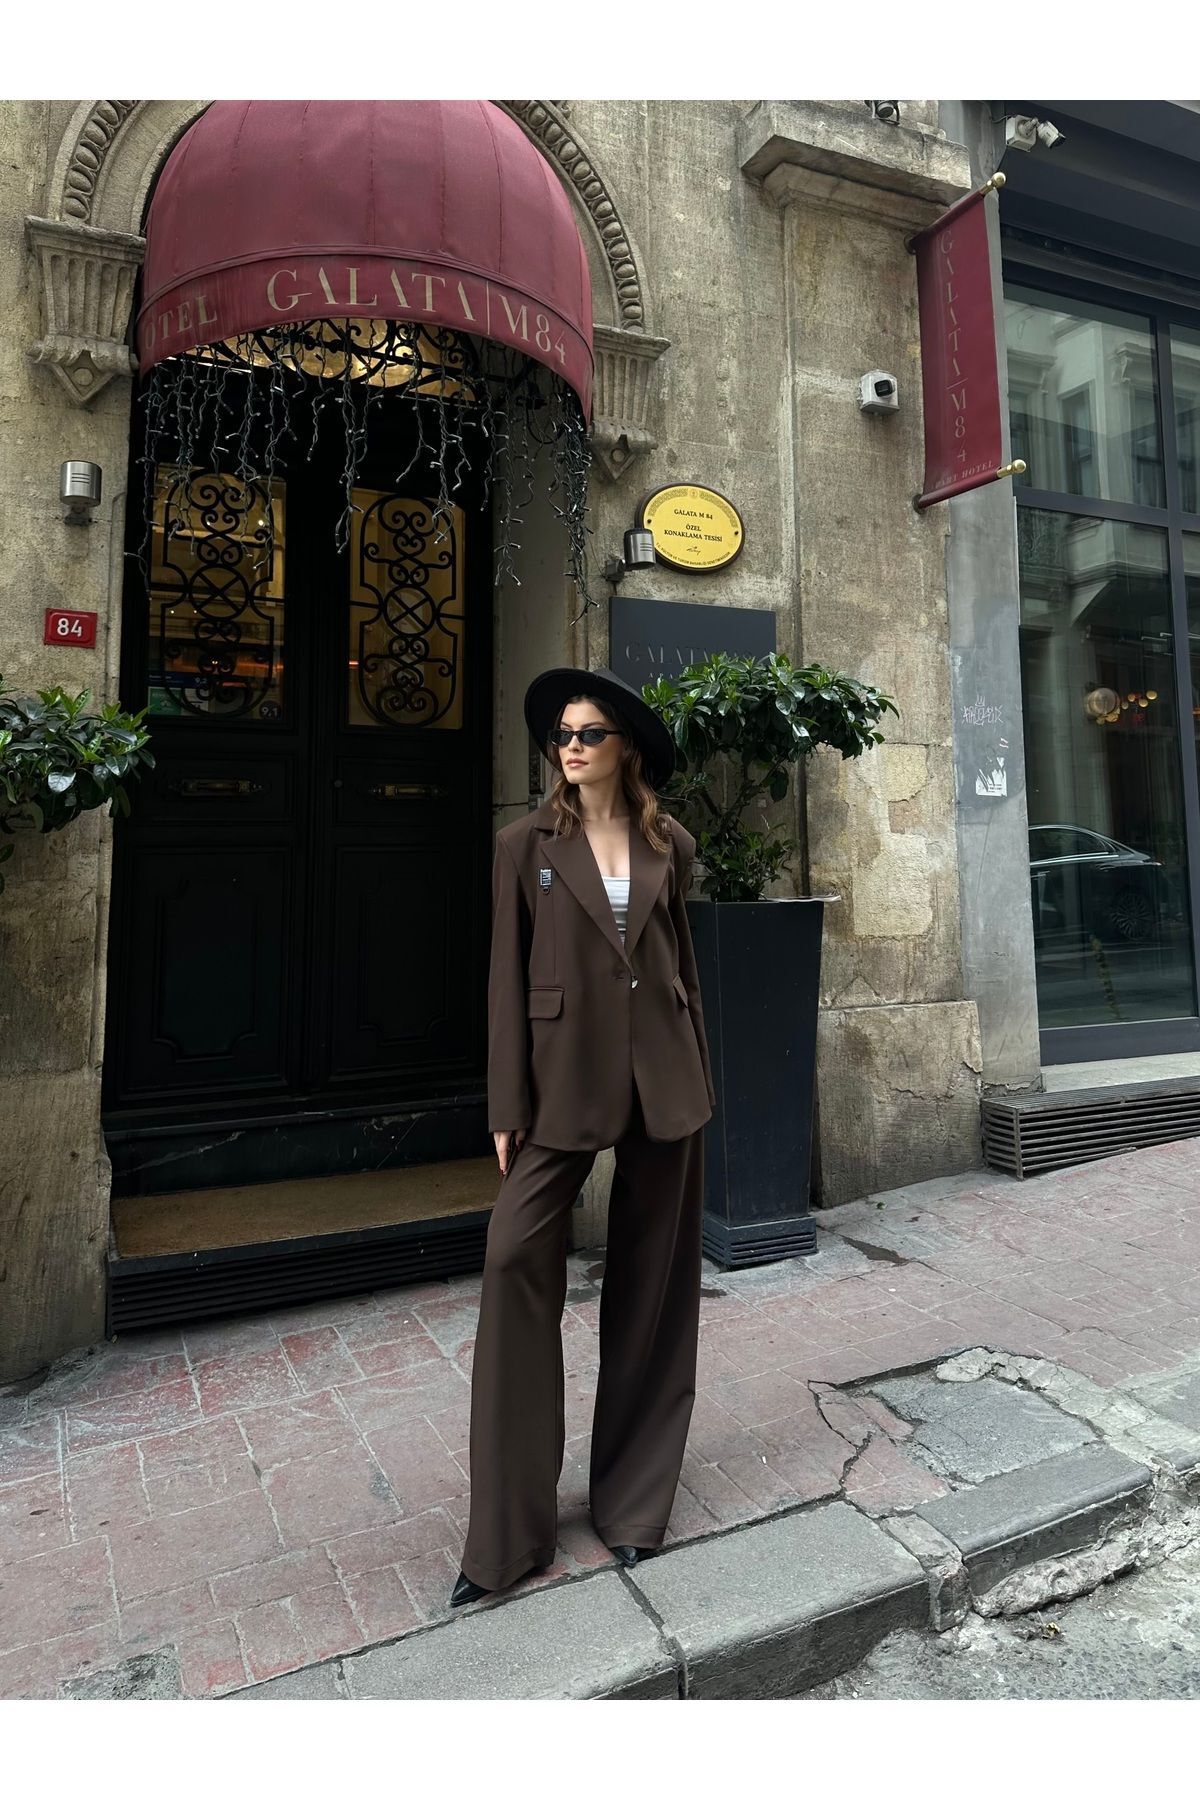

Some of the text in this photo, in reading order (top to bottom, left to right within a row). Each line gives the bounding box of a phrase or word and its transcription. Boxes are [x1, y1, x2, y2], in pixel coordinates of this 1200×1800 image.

[267, 266, 477, 322] GALATA
[940, 230, 961, 377] GALATA
[961, 460, 992, 479] HOTEL
[674, 509, 698, 518] GALATA
[664, 529, 703, 540] KONAKLAMA
[685, 524, 701, 532] ÖZEL
[57, 617, 82, 638] 84
